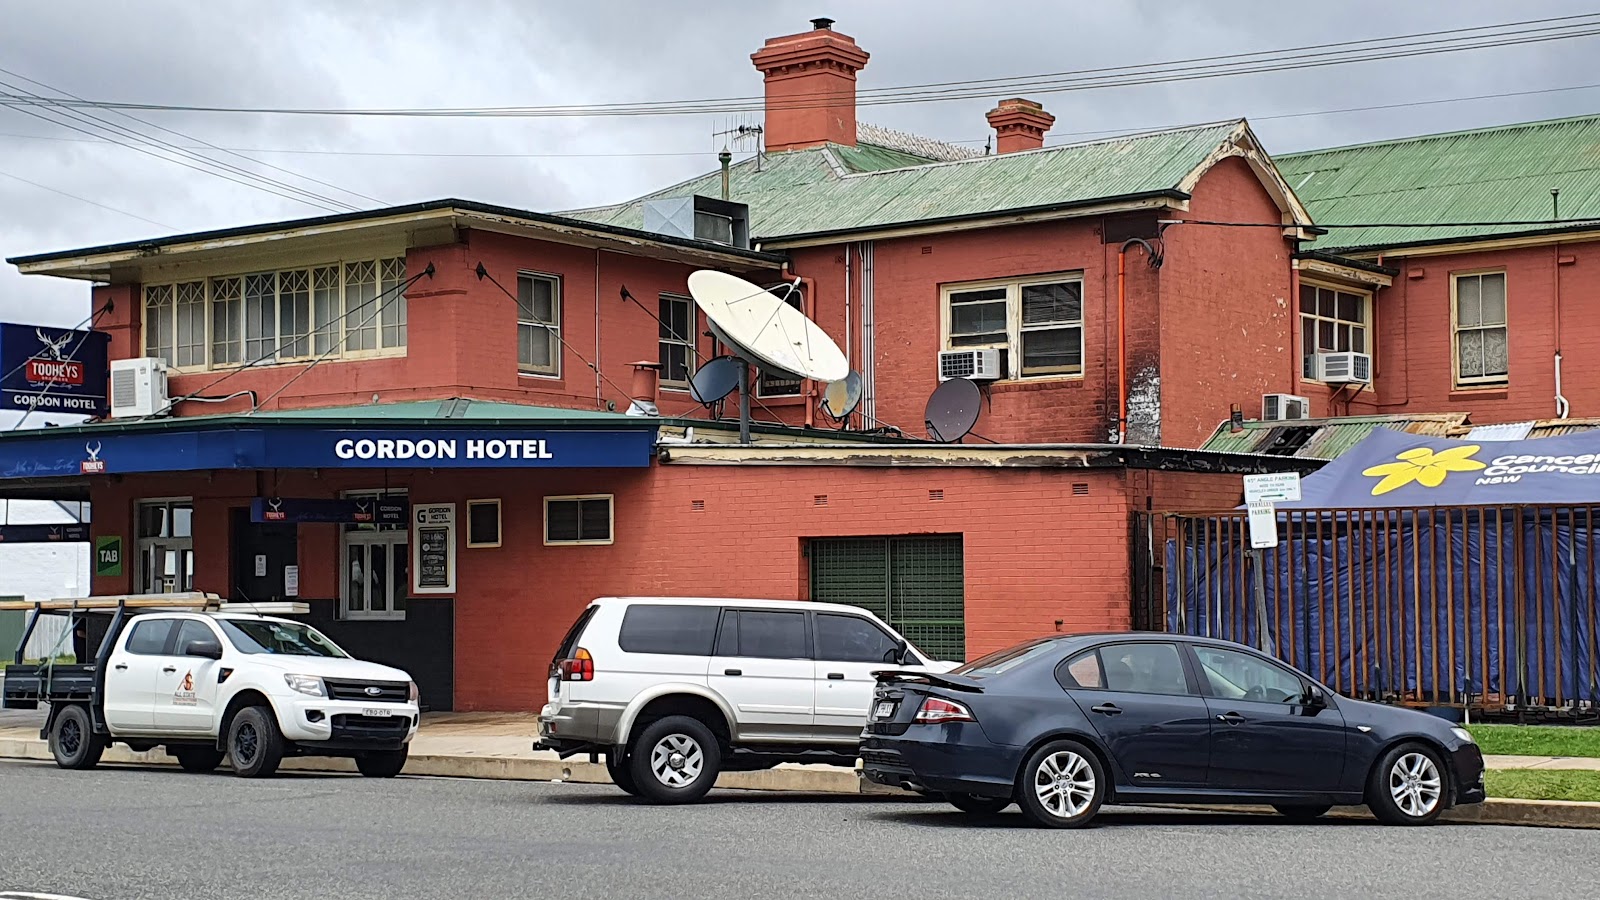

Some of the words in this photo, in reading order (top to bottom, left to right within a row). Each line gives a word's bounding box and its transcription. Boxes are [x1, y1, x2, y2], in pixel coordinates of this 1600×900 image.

[32, 362, 78, 379] TOOHEYS
[14, 395, 60, 407] GORDON
[64, 398, 97, 409] HOTEL
[335, 439, 457, 459] GORDON
[467, 439, 553, 459] HOTEL
[1475, 475, 1521, 485] NSW
[417, 509, 427, 523] G
[1251, 508, 1272, 516] PARKING
[100, 550, 118, 563] TAB
